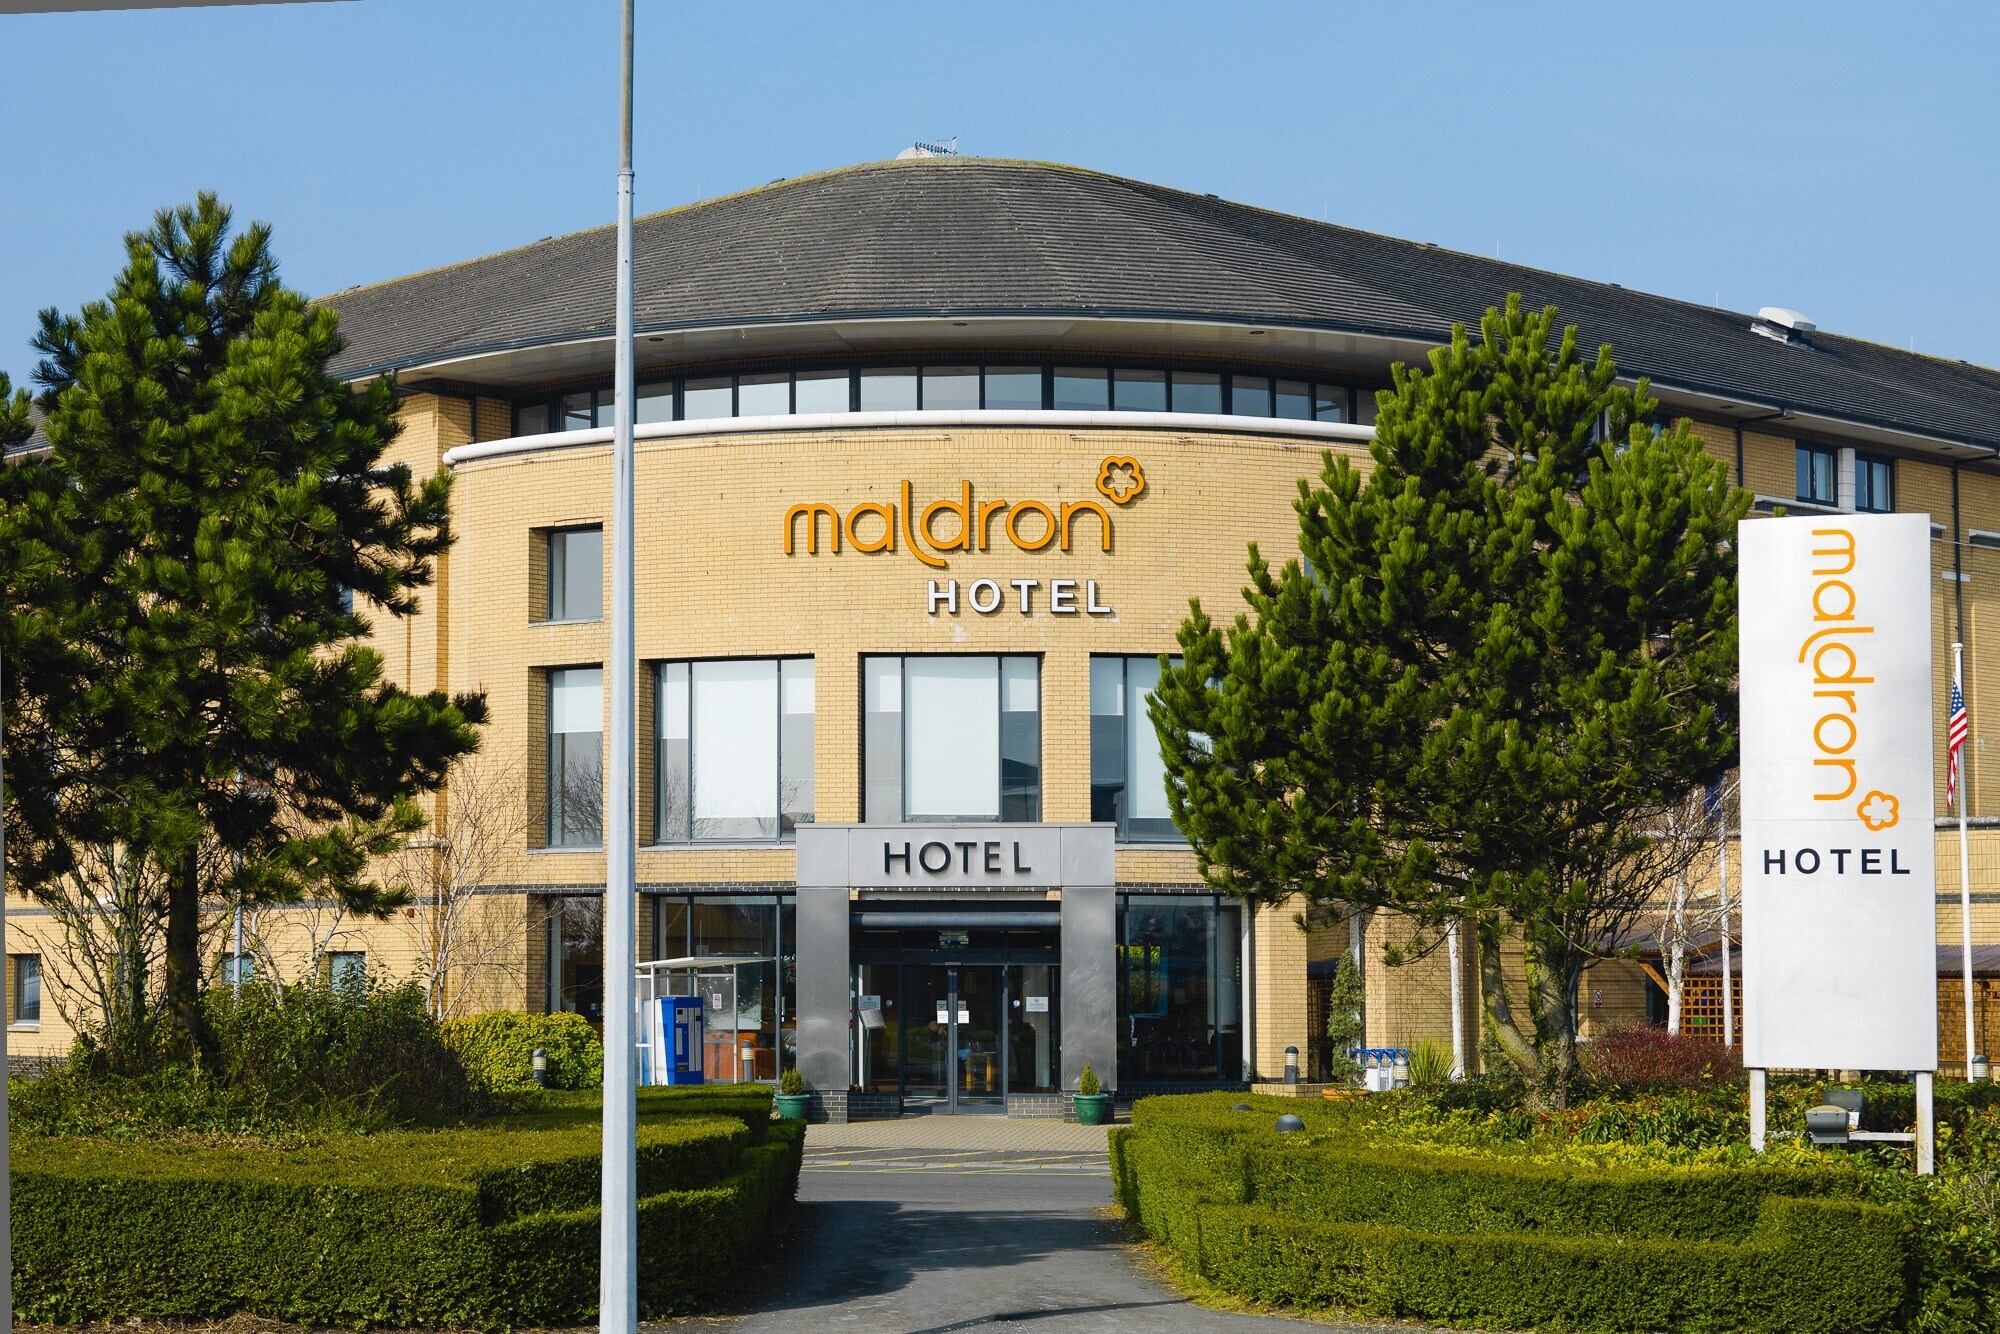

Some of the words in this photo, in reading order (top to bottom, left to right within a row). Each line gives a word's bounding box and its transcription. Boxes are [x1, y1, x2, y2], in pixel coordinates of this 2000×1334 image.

[784, 480, 1111, 567] maldron
[927, 577, 1112, 614] HOTEL
[1798, 529, 1875, 801] maldron
[884, 841, 1032, 874] HOTEL
[1763, 847, 1911, 875] HOTEL
